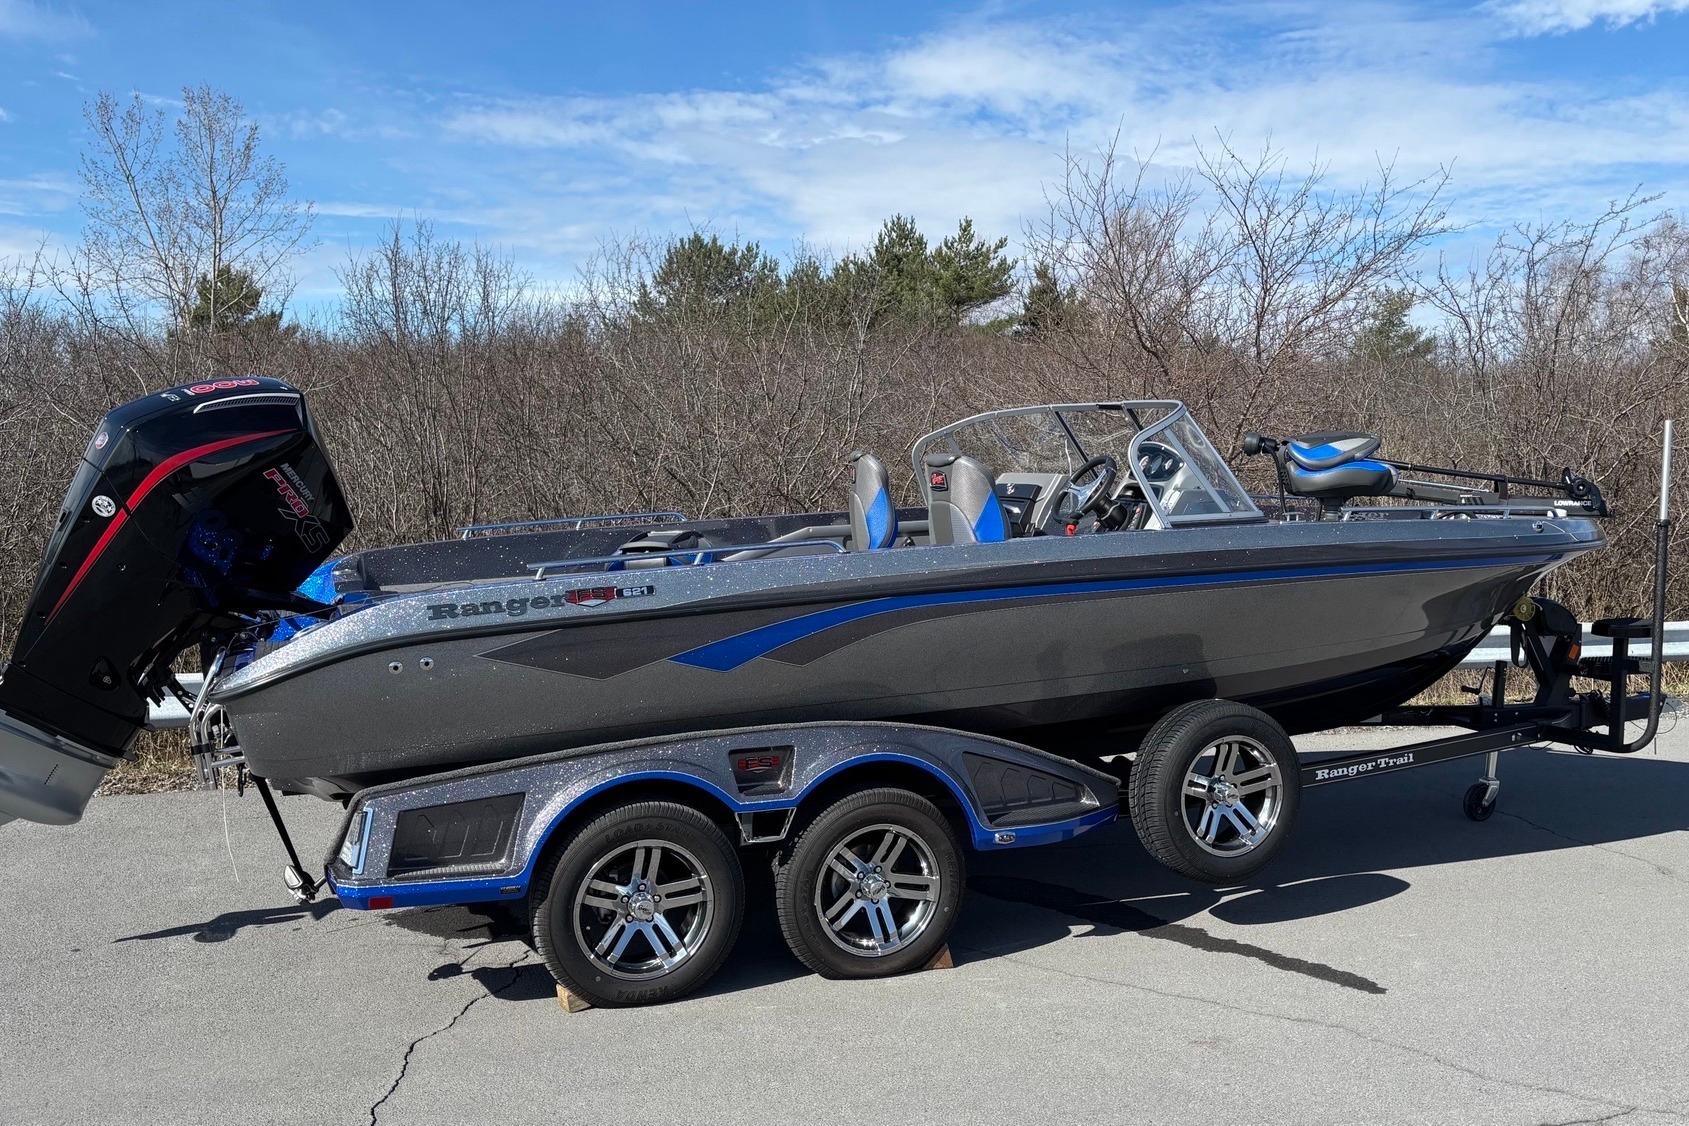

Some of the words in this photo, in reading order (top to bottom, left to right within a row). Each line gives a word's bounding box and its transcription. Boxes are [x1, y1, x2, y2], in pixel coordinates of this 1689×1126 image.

[263, 468, 310, 518] PRO
[280, 462, 315, 501] MERCURY
[277, 507, 330, 553] XS
[427, 594, 566, 620] Ranger
[622, 585, 648, 597] 621
[1315, 760, 1376, 780] Ranger
[1377, 753, 1414, 768] Trail
